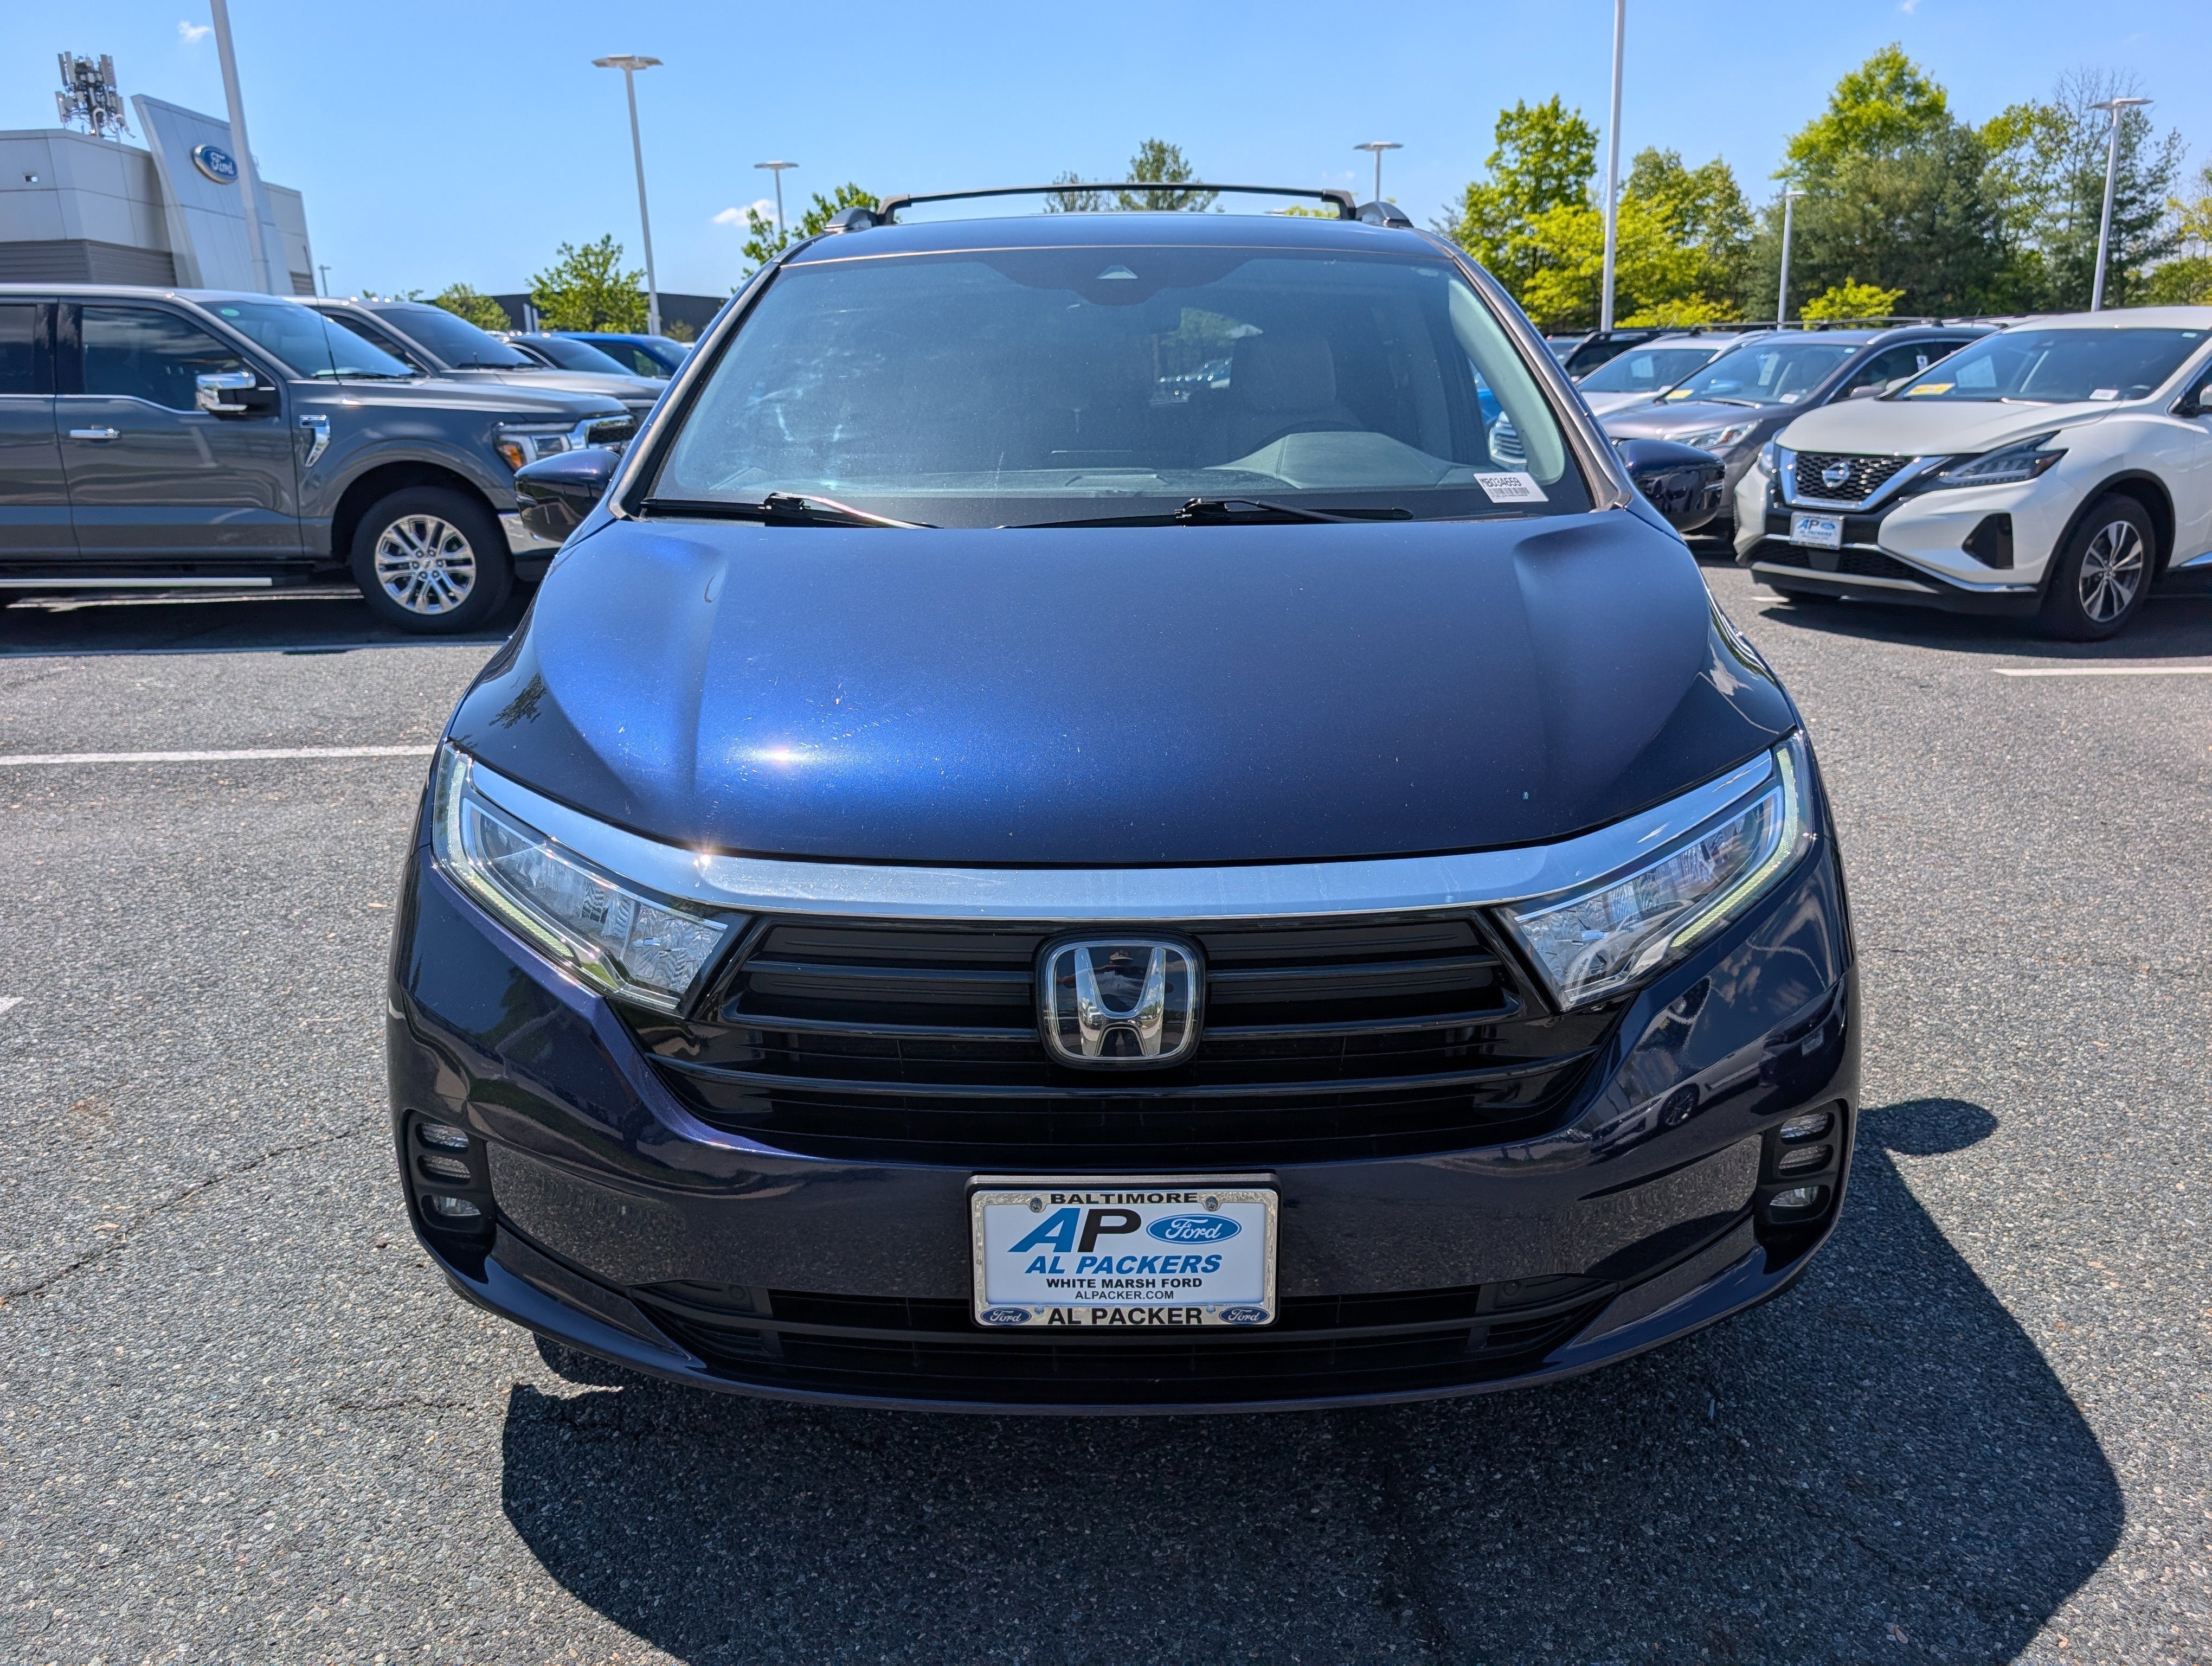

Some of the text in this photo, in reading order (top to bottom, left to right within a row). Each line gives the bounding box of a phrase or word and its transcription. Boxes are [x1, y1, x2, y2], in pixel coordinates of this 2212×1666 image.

[210, 151, 234, 175] Ford
[1479, 477, 1522, 488] MB034659
[1050, 1193, 1198, 1204] BALTIMORE
[1007, 1207, 1142, 1253] AP
[1165, 1218, 1222, 1240] Ford
[1024, 1254, 1223, 1274] AL PACKERS
[1046, 1278, 1203, 1288] WHITE MARSH FORD
[1075, 1290, 1174, 1300] ALPACKER.COM
[989, 1310, 1022, 1323] Ford
[1047, 1308, 1203, 1325] AL PACKER
[1227, 1310, 1261, 1322] Ford
